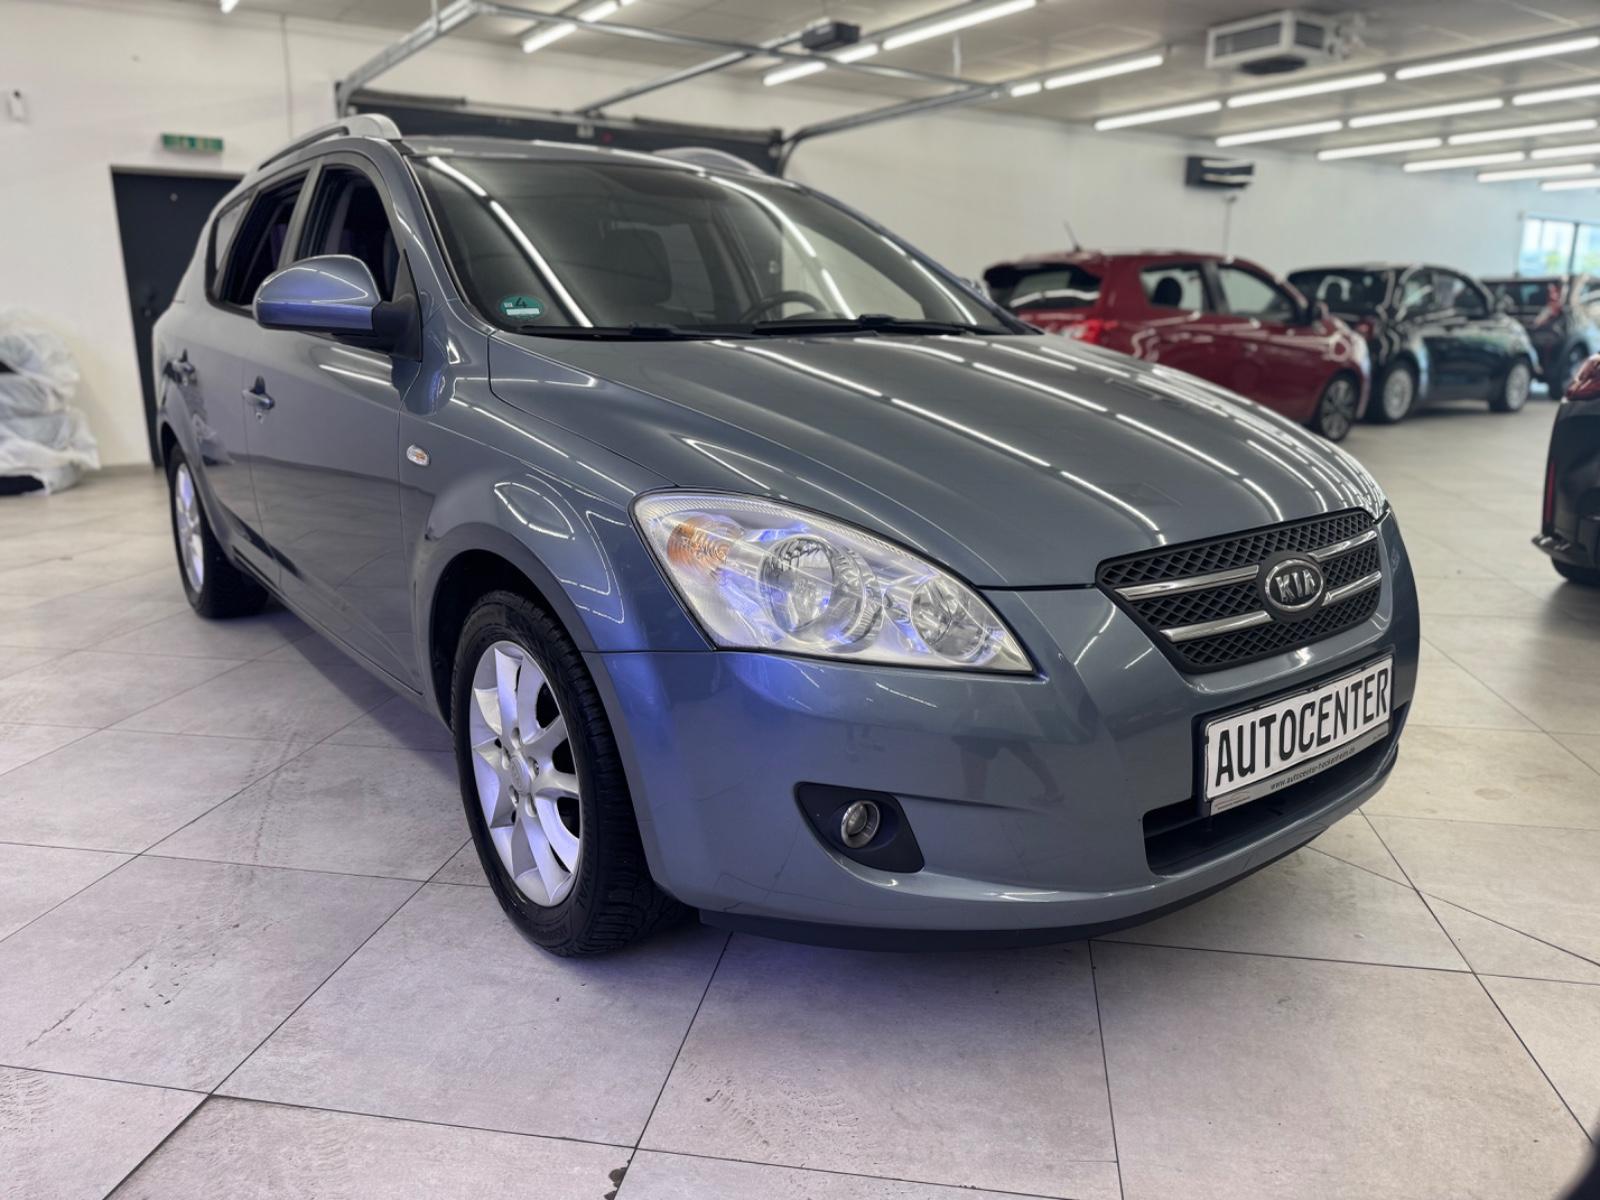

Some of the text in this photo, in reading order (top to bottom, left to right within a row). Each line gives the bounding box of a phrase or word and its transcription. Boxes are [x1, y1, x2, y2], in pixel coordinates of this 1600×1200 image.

[515, 297, 527, 308] 4
[1275, 569, 1316, 602] KIA
[1215, 667, 1389, 788] AUTOCENTER
